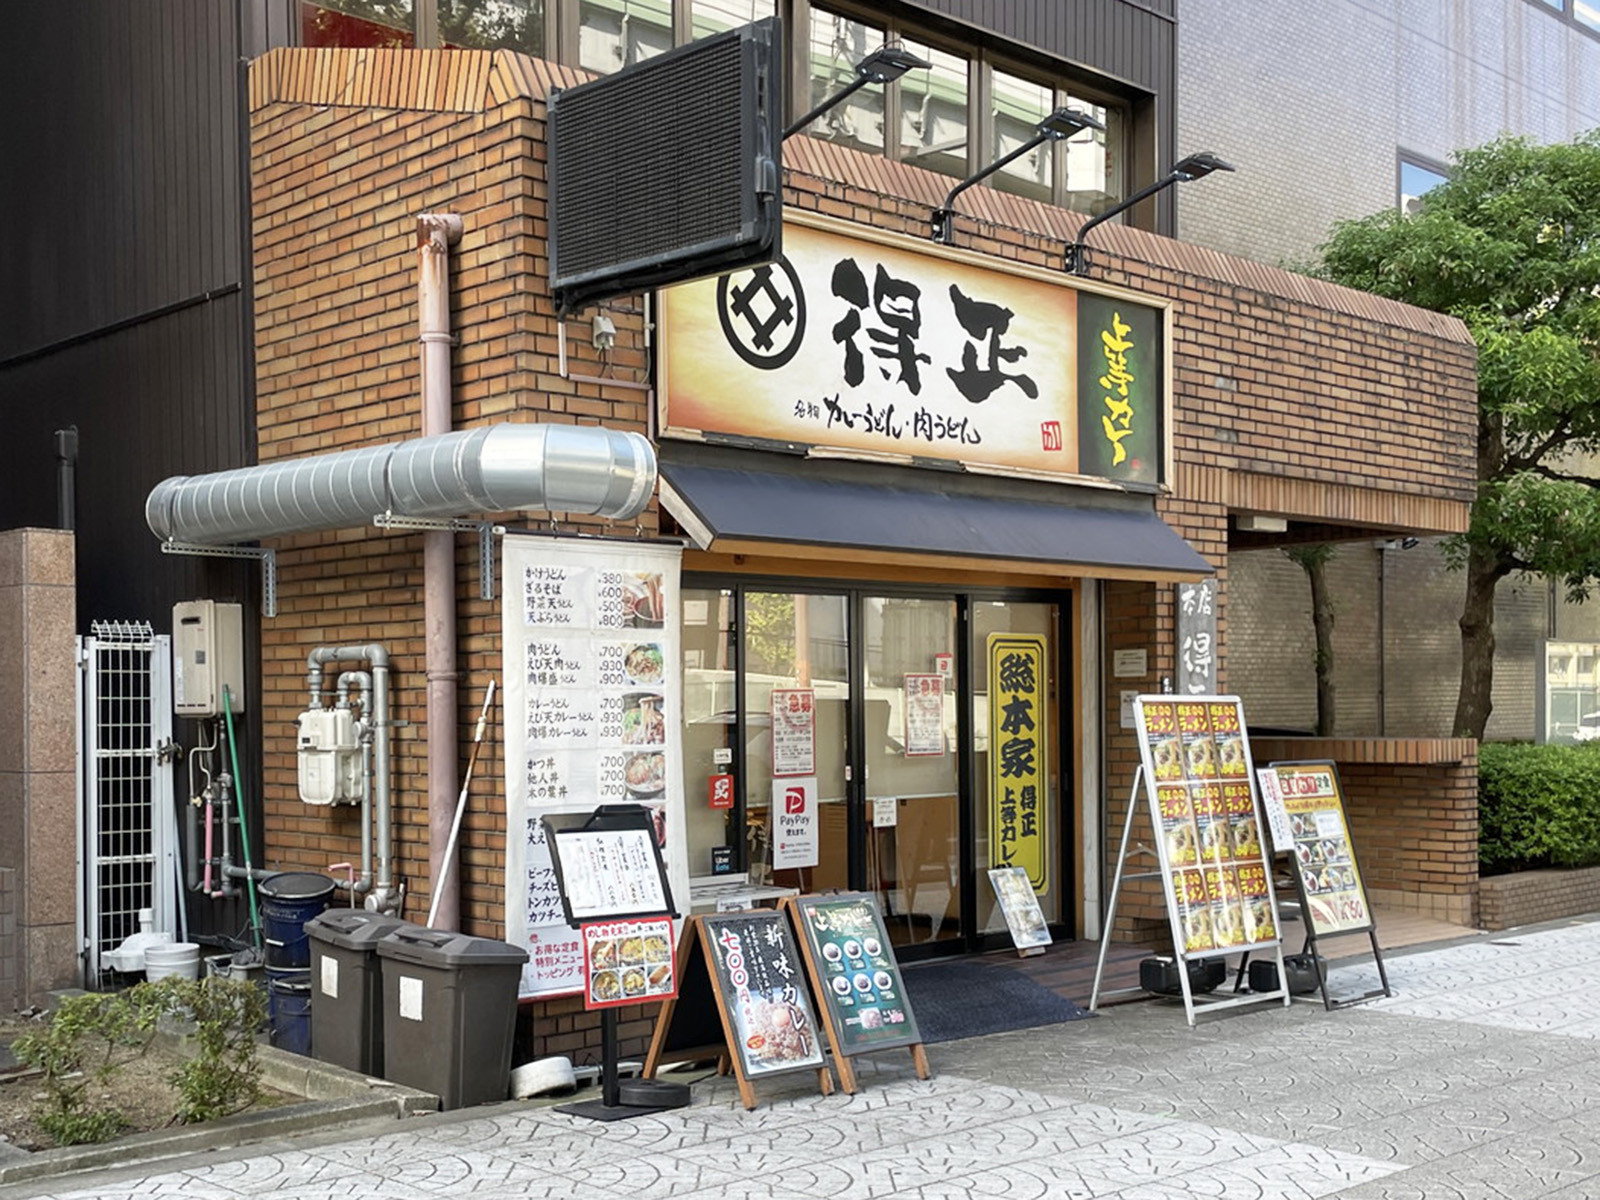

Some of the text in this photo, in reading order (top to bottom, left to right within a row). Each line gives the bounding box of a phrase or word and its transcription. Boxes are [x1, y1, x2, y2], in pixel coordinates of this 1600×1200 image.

[831, 257, 1038, 404] 得正
[525, 566, 567, 581] かけうどん
[525, 582, 562, 595] ざるそば
[527, 642, 560, 656] 肉うどん
[528, 698, 570, 710] カレーうどん
[1000, 652, 1036, 779] 総本家
[780, 815, 811, 826] PayPay
[1000, 787, 1017, 868] 上等カレ
[1020, 785, 1037, 838] 得正
[764, 924, 811, 1057] 新味カレー
